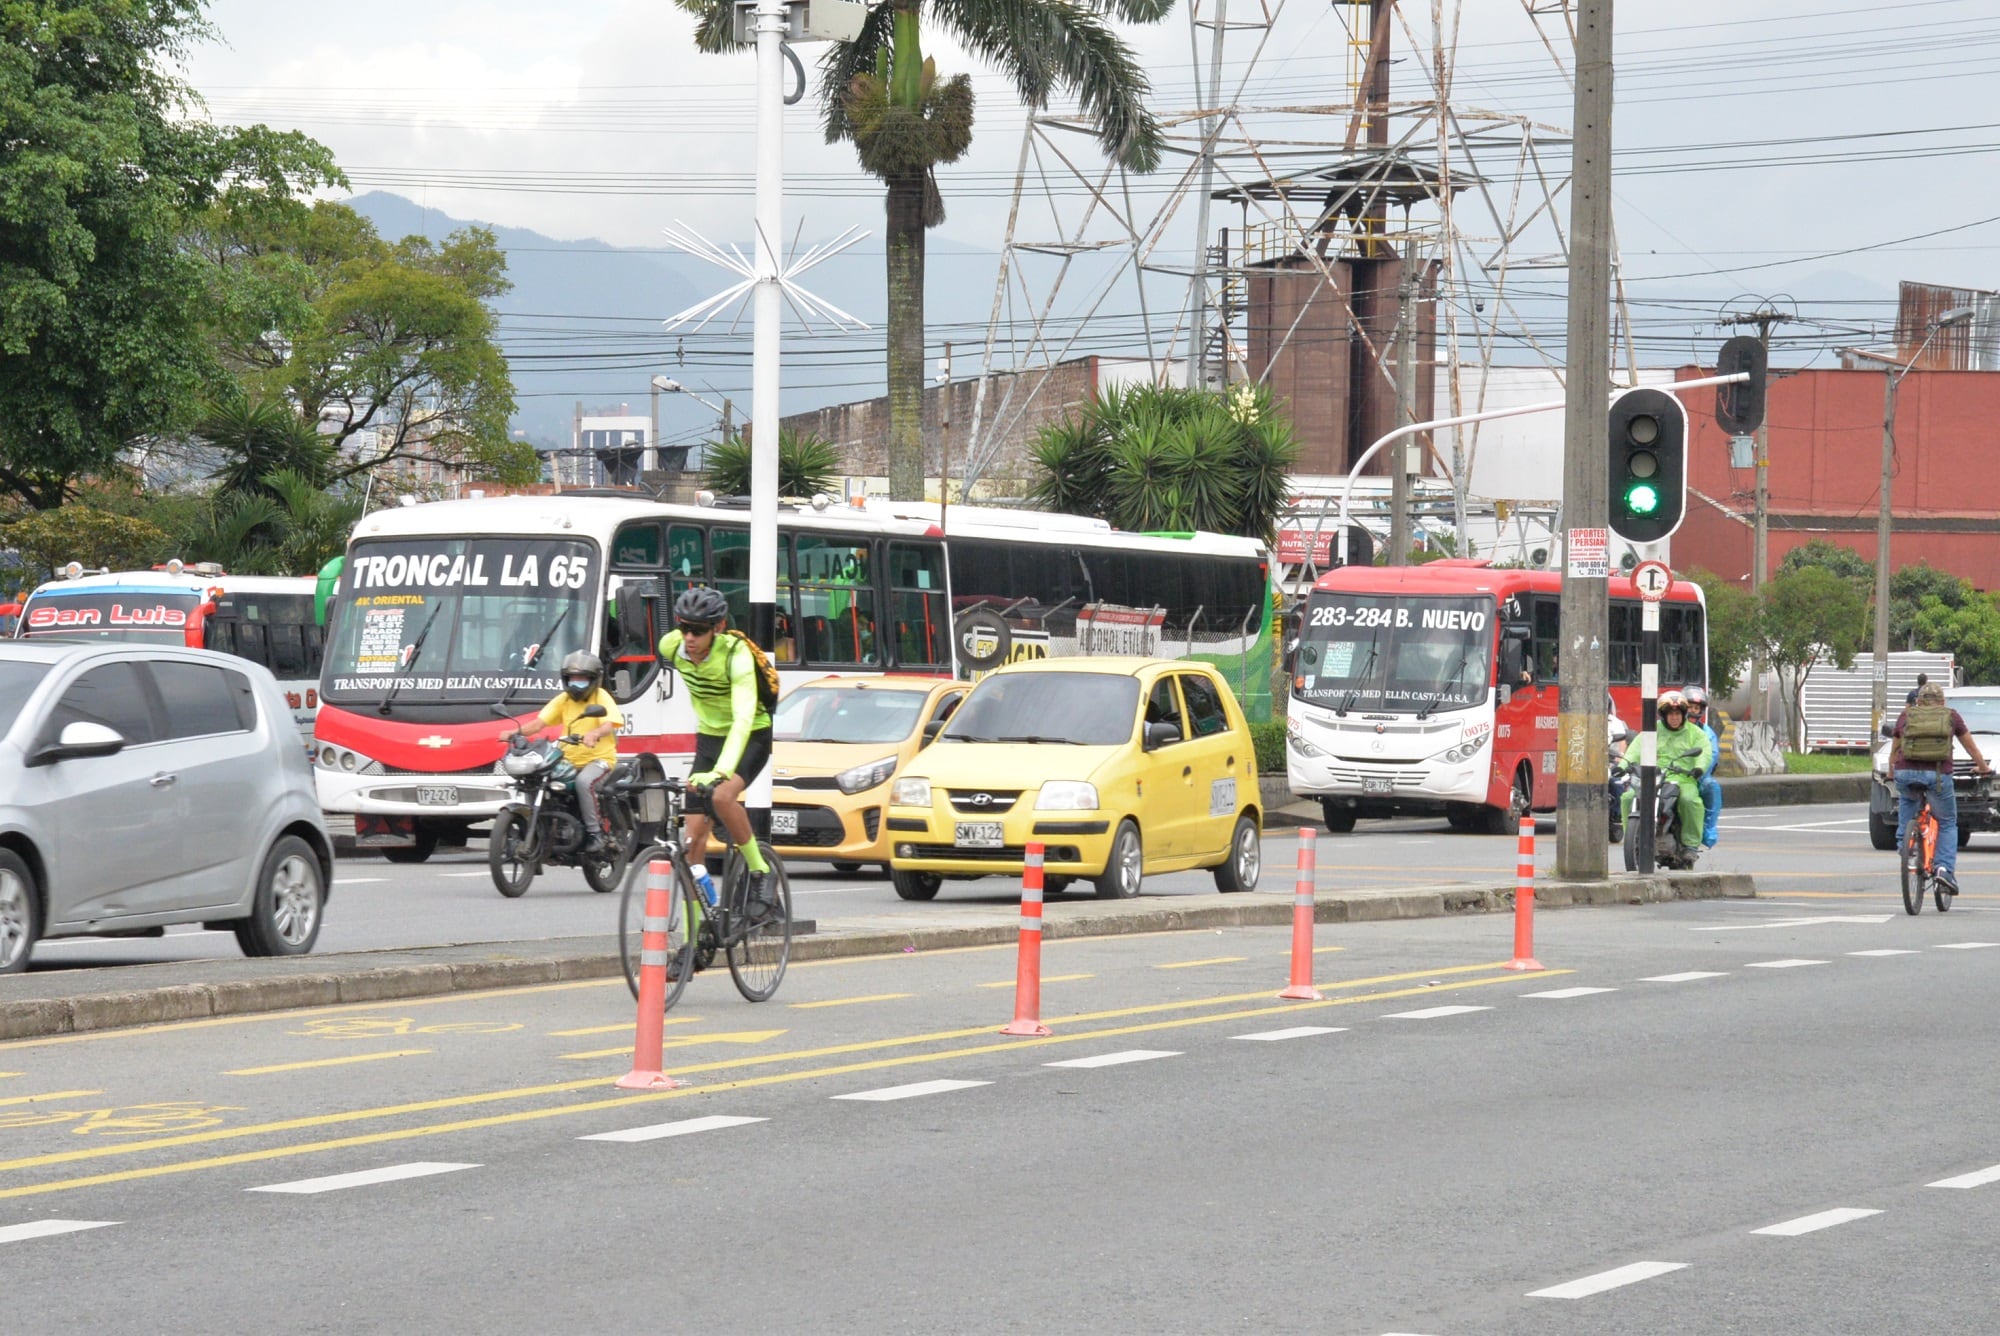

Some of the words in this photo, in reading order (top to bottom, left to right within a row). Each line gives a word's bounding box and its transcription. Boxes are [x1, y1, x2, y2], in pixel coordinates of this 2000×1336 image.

[353, 554, 488, 589] TRONCAL
[500, 554, 539, 587] LA
[548, 555, 588, 589] 65
[373, 594, 425, 605] ORIENTAL
[28, 606, 101, 627] San
[109, 604, 186, 627] Luis
[1310, 606, 1391, 628] 283-284
[1395, 608, 1413, 628] B.
[1422, 608, 1485, 632] NUEVO
[334, 678, 415, 691] TRANSPORTES
[484, 677, 542, 690] CASTILLA
[1465, 722, 1490, 737] 0075
[1497, 724, 1511, 738] 0075
[956, 825, 1002, 840] SMV-122
